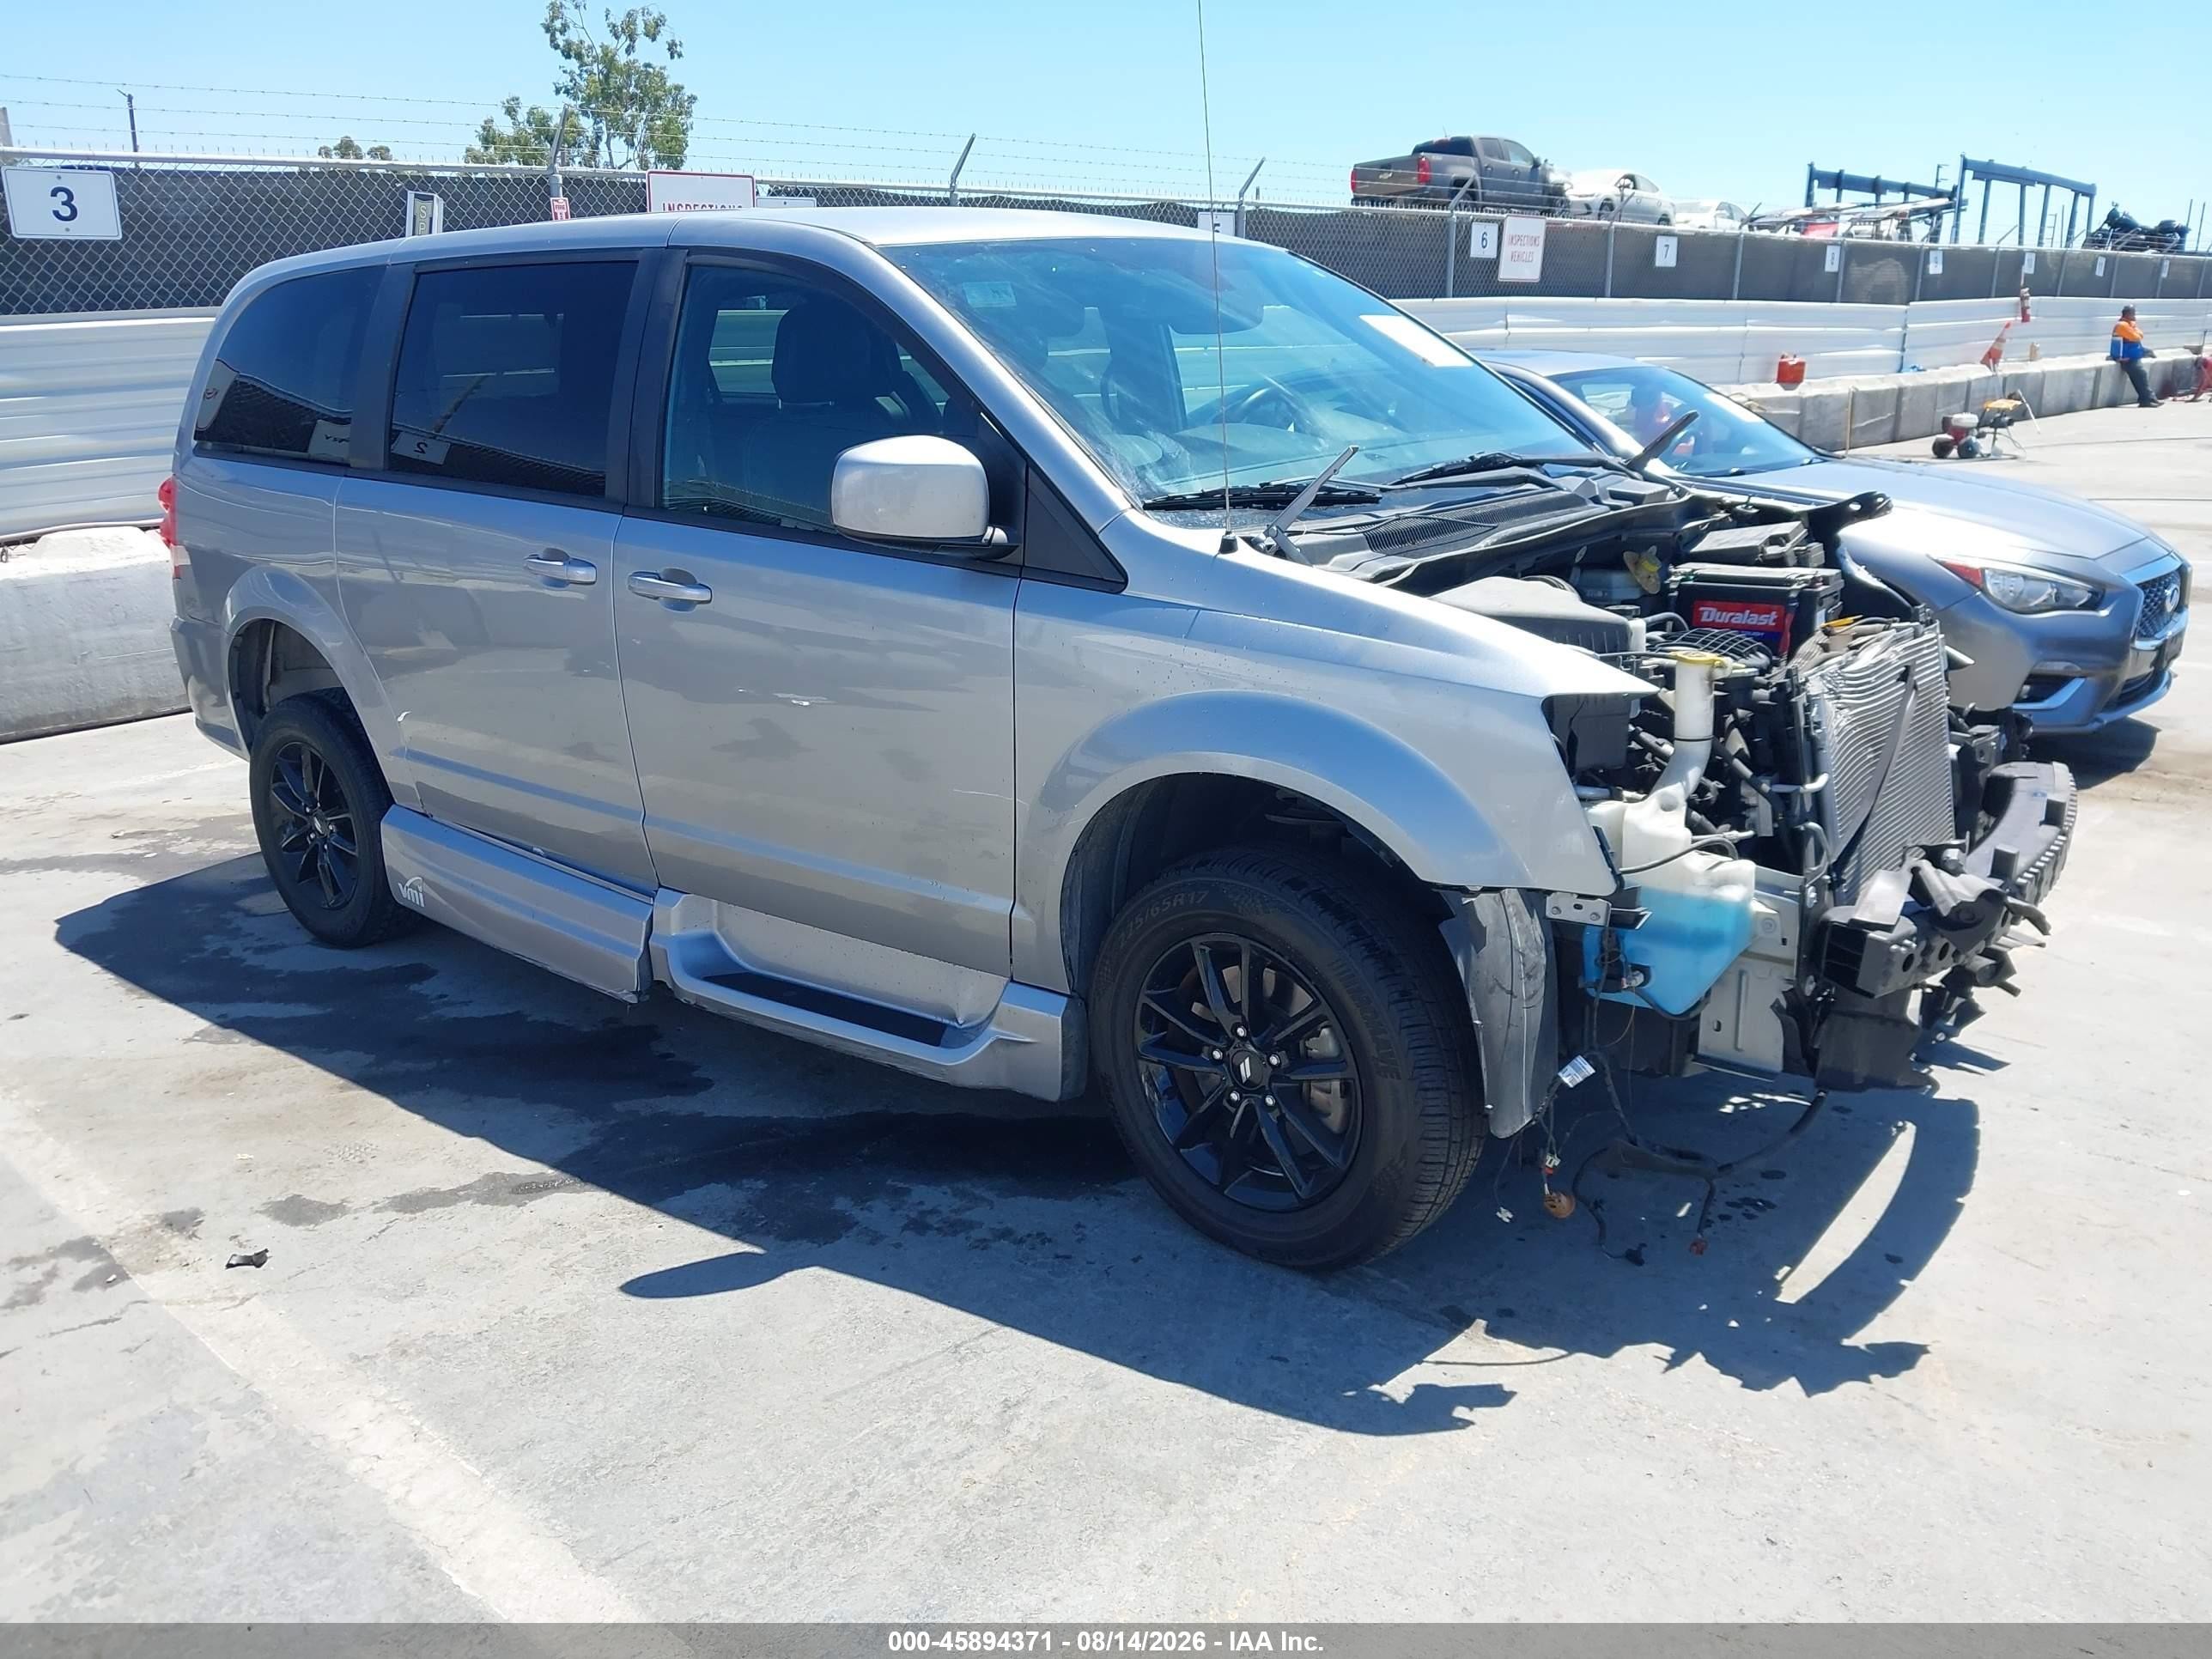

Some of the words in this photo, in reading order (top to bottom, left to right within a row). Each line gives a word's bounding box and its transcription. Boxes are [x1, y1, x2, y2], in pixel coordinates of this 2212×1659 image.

[50, 185, 78, 222] 3
[1480, 231, 1488, 249] 6
[1663, 244, 1670, 259] 7
[1698, 606, 1778, 626] Duralast
